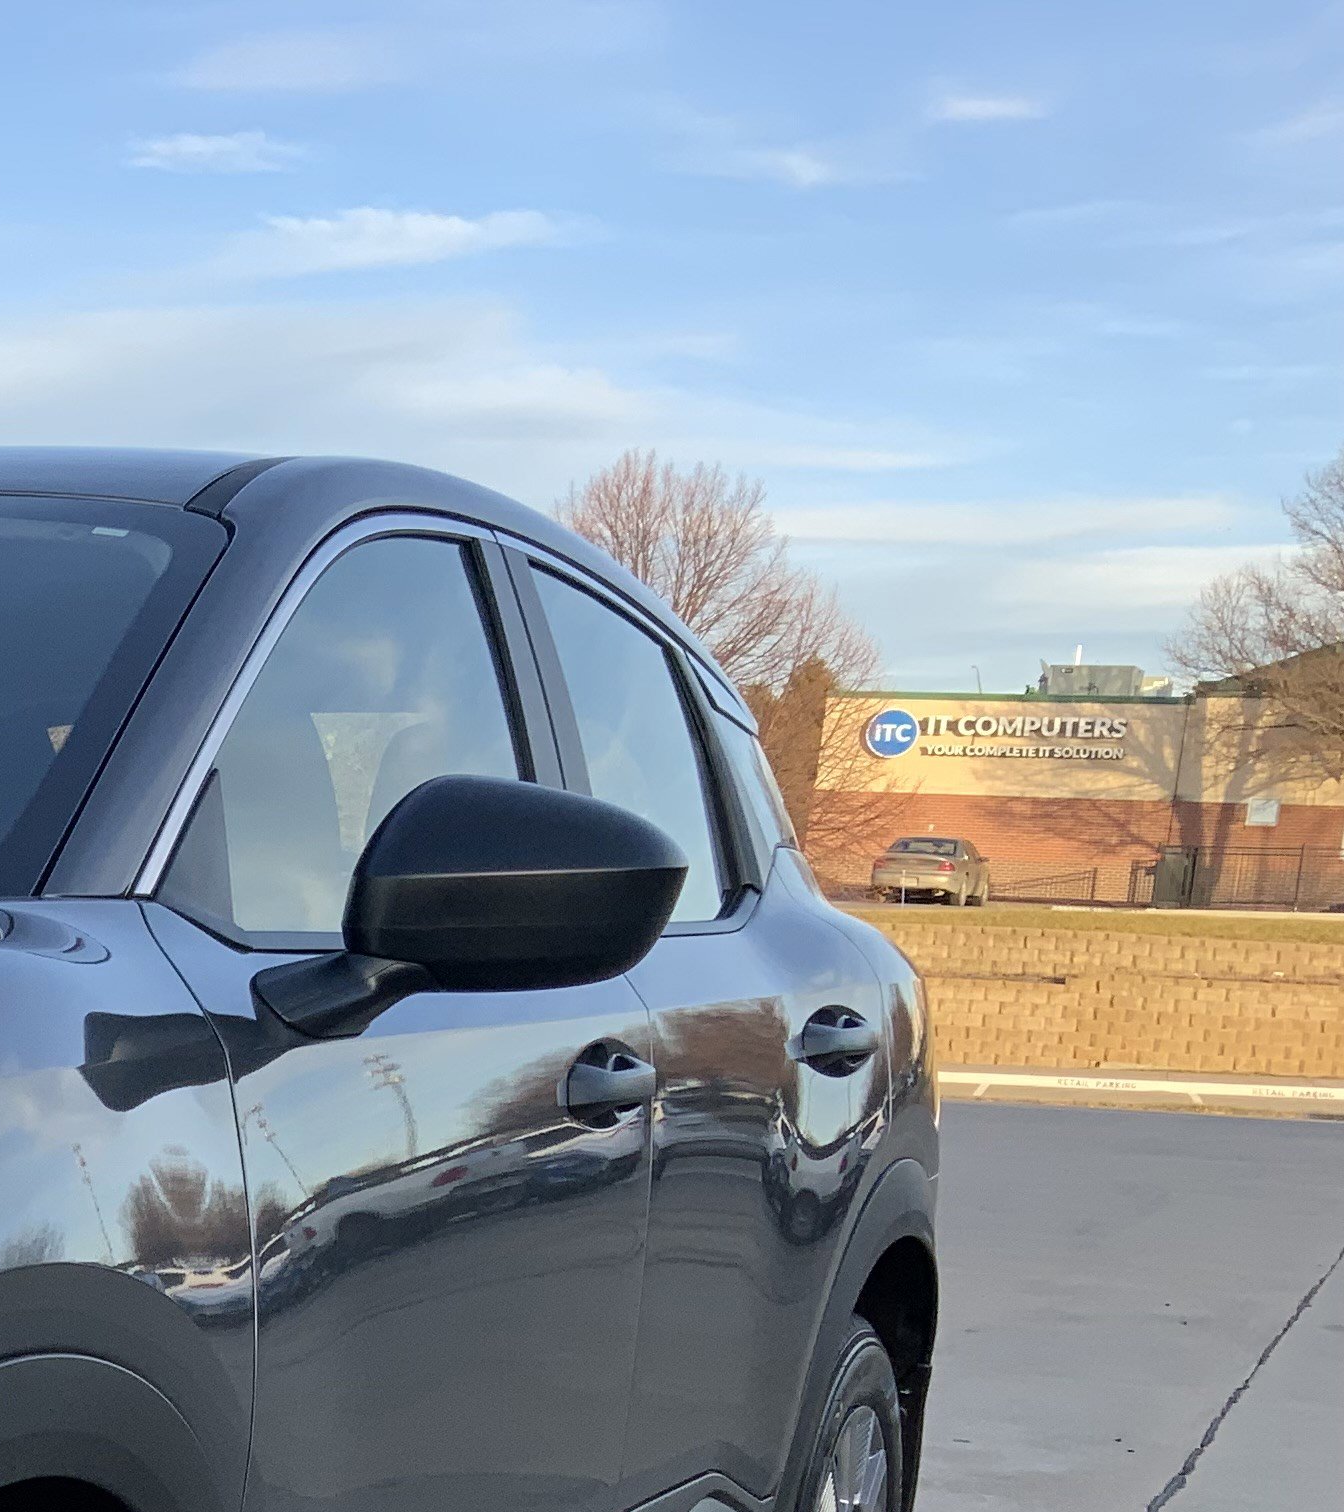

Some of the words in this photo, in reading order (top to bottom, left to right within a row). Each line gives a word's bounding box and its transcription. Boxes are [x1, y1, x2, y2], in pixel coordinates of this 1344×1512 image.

[926, 715, 953, 735] IT
[957, 716, 1127, 739] COMPUTERS
[926, 744, 964, 757] YOUR
[965, 745, 1038, 758] COMPLETE
[1038, 746, 1054, 758] IT
[1054, 746, 1124, 760] SOLUTION
[1057, 1078, 1089, 1087] RETAIL
[1095, 1080, 1137, 1089] PARKING
